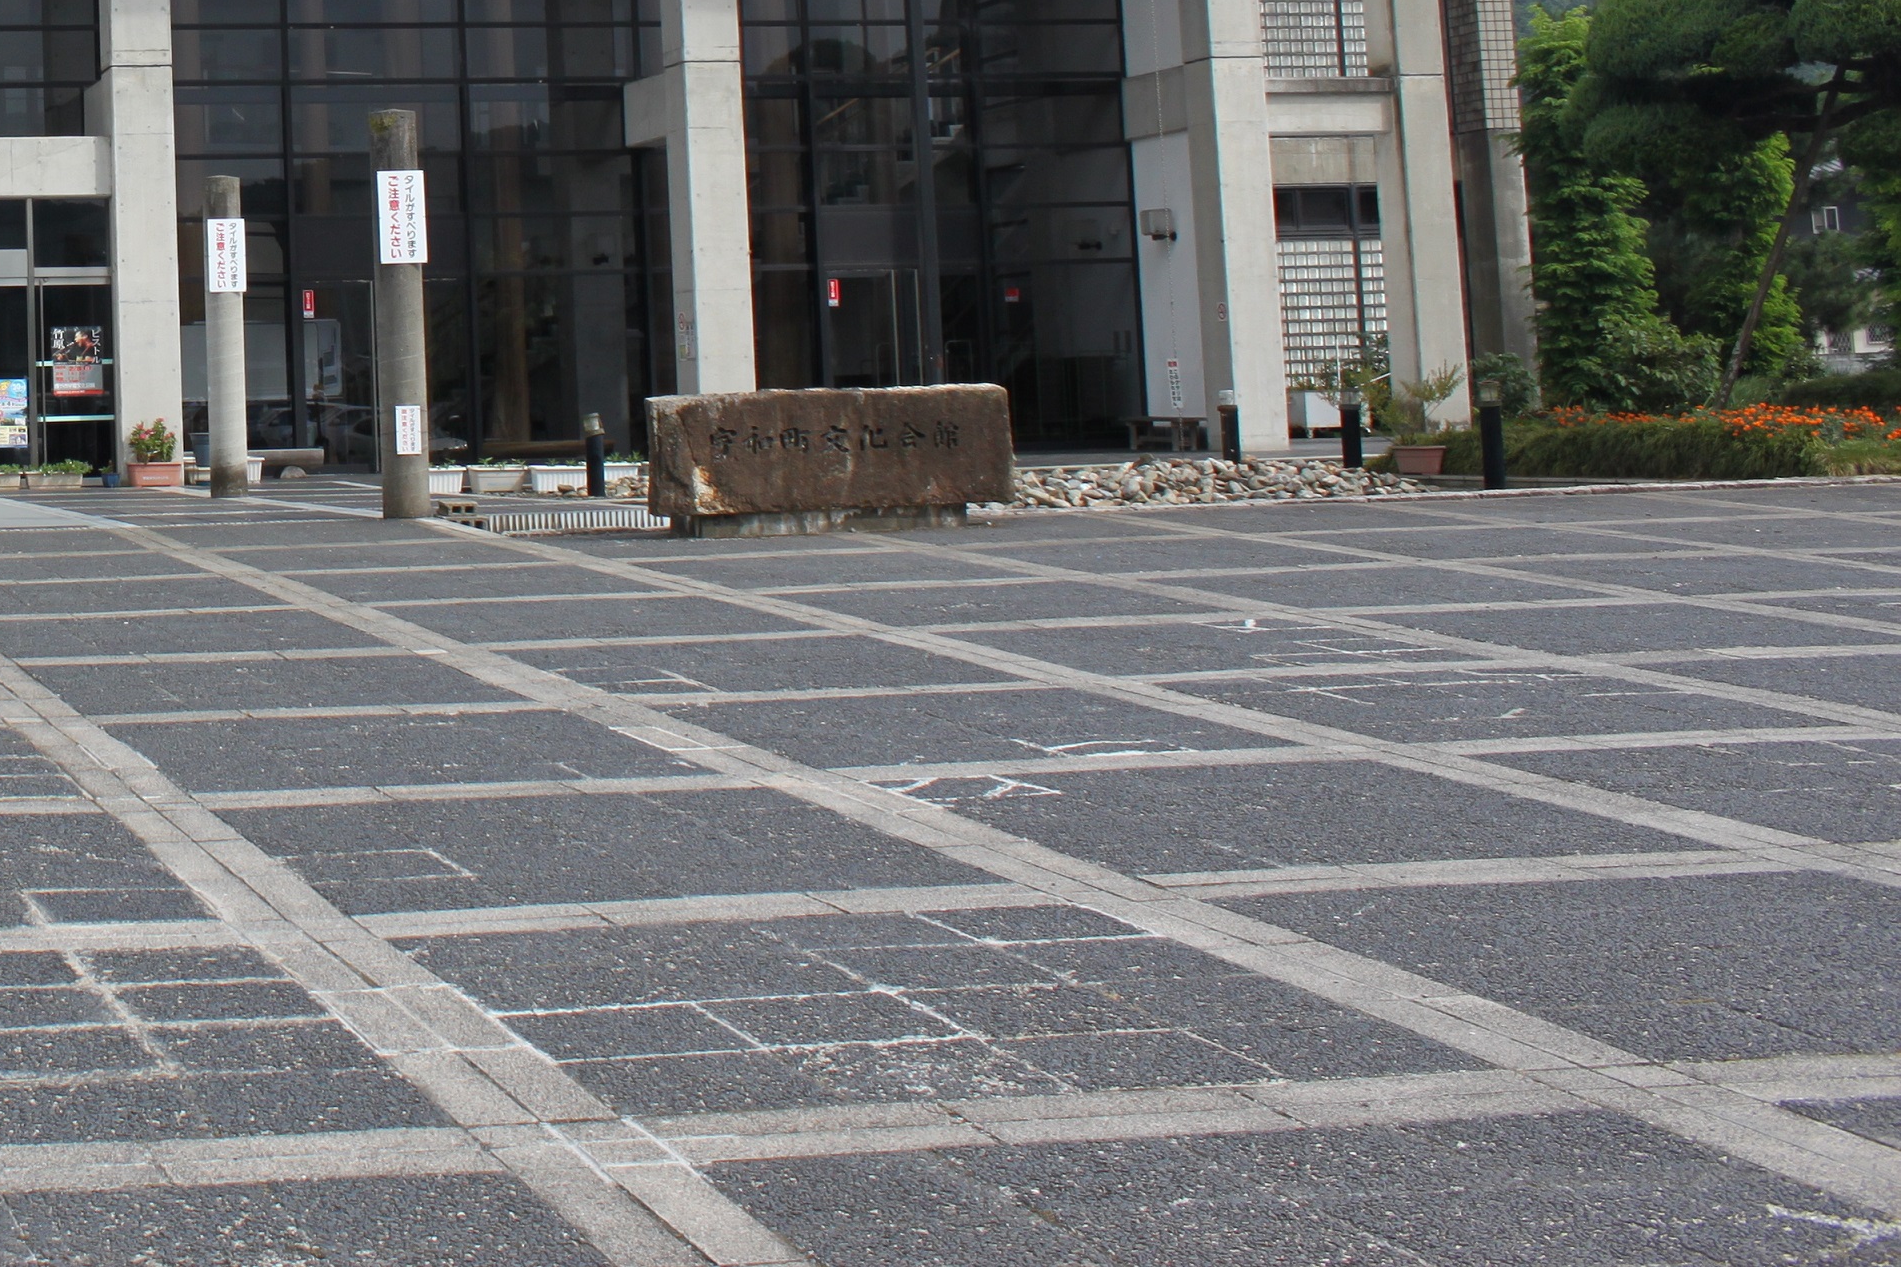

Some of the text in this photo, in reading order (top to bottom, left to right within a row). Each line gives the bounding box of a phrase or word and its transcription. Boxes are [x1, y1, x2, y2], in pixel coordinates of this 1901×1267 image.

[387, 174, 403, 259] ご注意ください
[404, 174, 417, 258] タイルがすべります
[215, 221, 227, 288] ご注意ください
[228, 221, 238, 288] タイルがすべります
[52, 328, 66, 349] 竹原
[91, 328, 102, 364] ピストル
[710, 421, 960, 455] 宇和町文化会館
